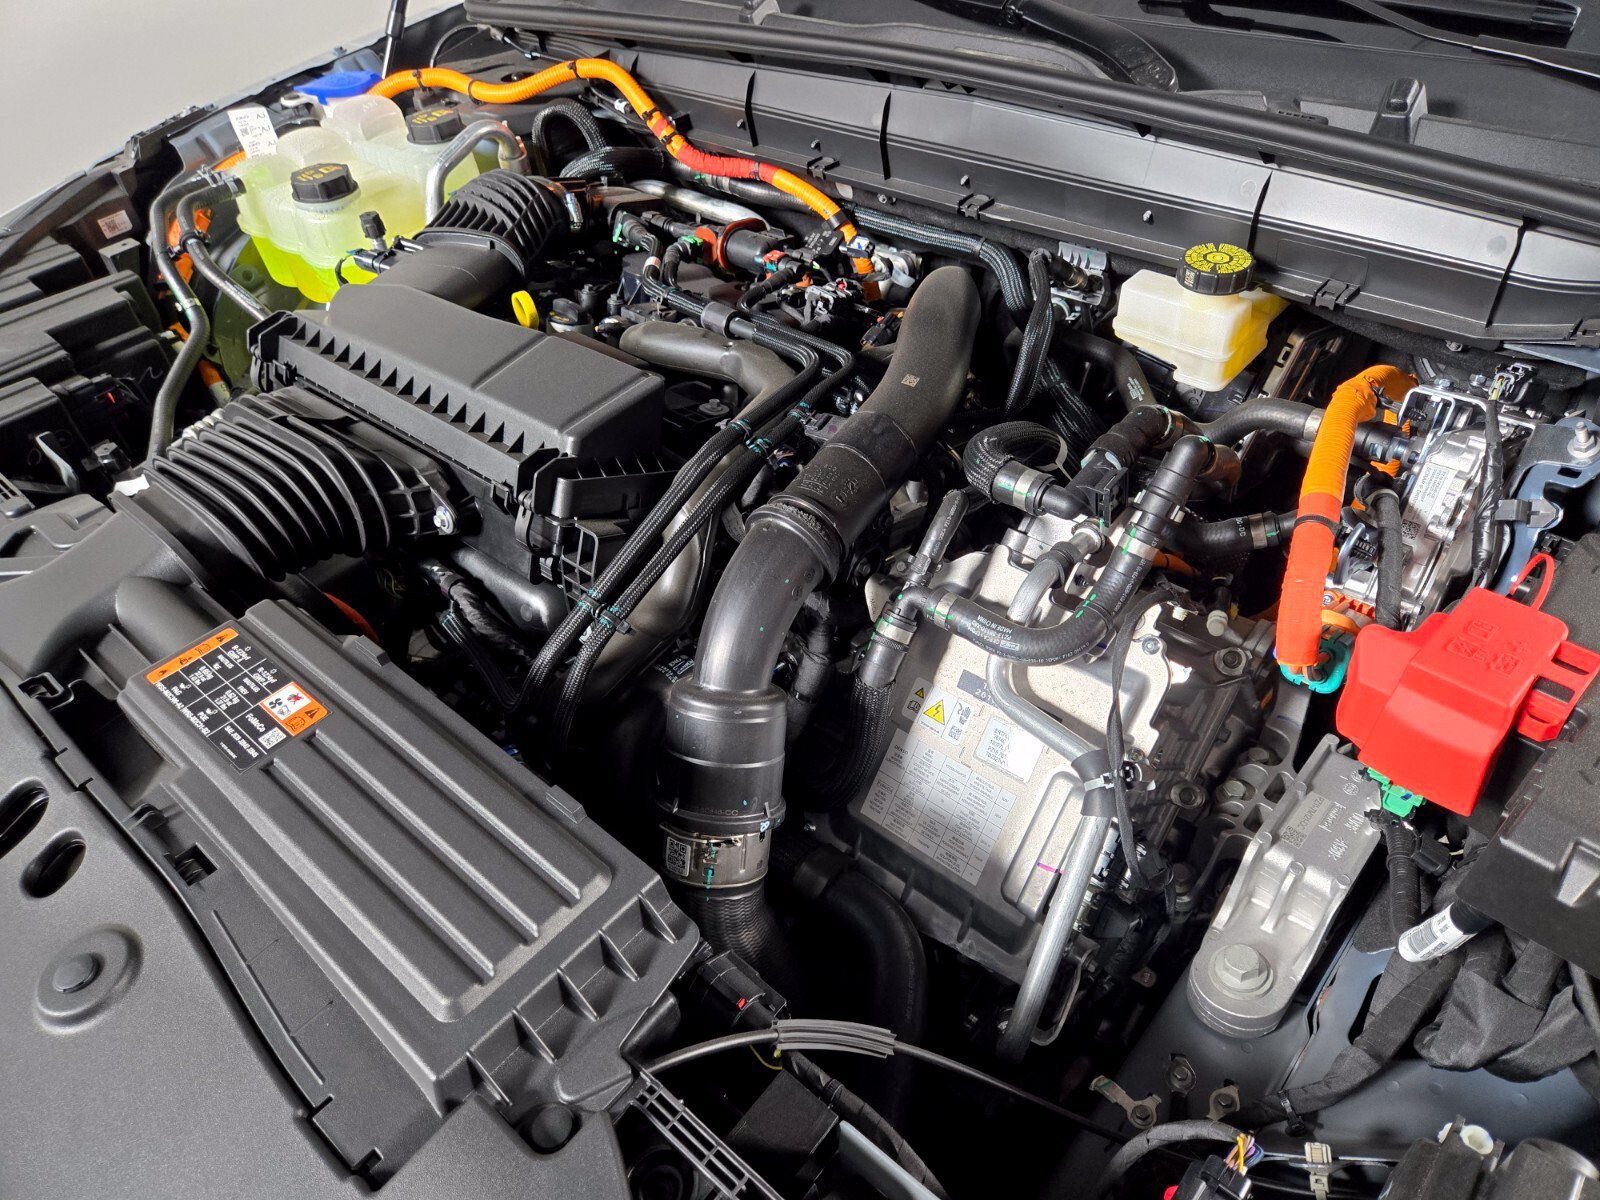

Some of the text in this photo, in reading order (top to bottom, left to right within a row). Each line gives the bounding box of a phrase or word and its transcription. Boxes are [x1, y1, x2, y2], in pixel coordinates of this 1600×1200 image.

[977, 615, 991, 626] CHINA
[996, 625, 1012, 633] MADE
[245, 713, 265, 731] FoMoCo
